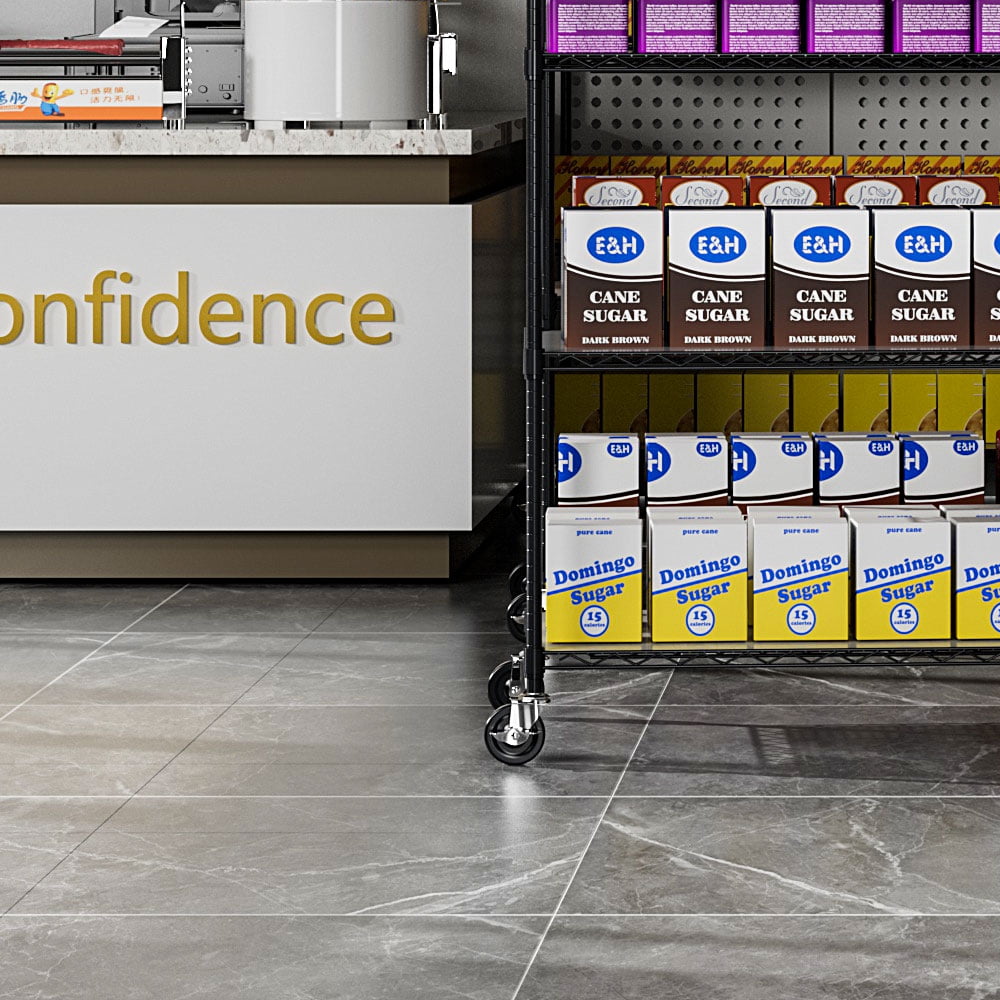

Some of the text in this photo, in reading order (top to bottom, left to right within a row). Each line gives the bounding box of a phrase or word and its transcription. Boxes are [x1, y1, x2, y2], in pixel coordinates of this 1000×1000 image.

[558, 160, 608, 175] Honey
[589, 185, 637, 205] Second
[932, 184, 980, 205] Second
[595, 236, 637, 254] E&H
[697, 236, 739, 254] E&H
[801, 236, 844, 254] E&H
[904, 235, 944, 254] E&H
[589, 291, 640, 303] CANE
[692, 290, 742, 303] CANE
[796, 290, 847, 303] CANE
[898, 290, 948, 302] CANE
[583, 309, 648, 322] SUGAR
[685, 309, 750, 321] SUGAR
[790, 308, 854, 321] SUGAR
[891, 308, 955, 320] SUGAR
[582, 336, 649, 344] DARK BROWN
[684, 336, 712, 344] DARK
[890, 335, 957, 343] DARK BROWN
[611, 444, 629, 454] E&H
[785, 443, 804, 453] E&H
[872, 443, 890, 452] E&H
[957, 442, 975, 451] E&H
[553, 556, 635, 585] Domingo
[659, 555, 741, 584] Domingo
[760, 554, 842, 584] Domingo
[864, 553, 944, 583] Domingo
[571, 582, 625, 605] Sugar
[677, 581, 731, 604] Sugar
[778, 580, 831, 603] Sugar
[881, 579, 934, 602] Sugar
[588, 610, 601, 621] 15
[694, 610, 707, 621] 15
[795, 609, 808, 620] 15
[898, 609, 911, 619] 15
